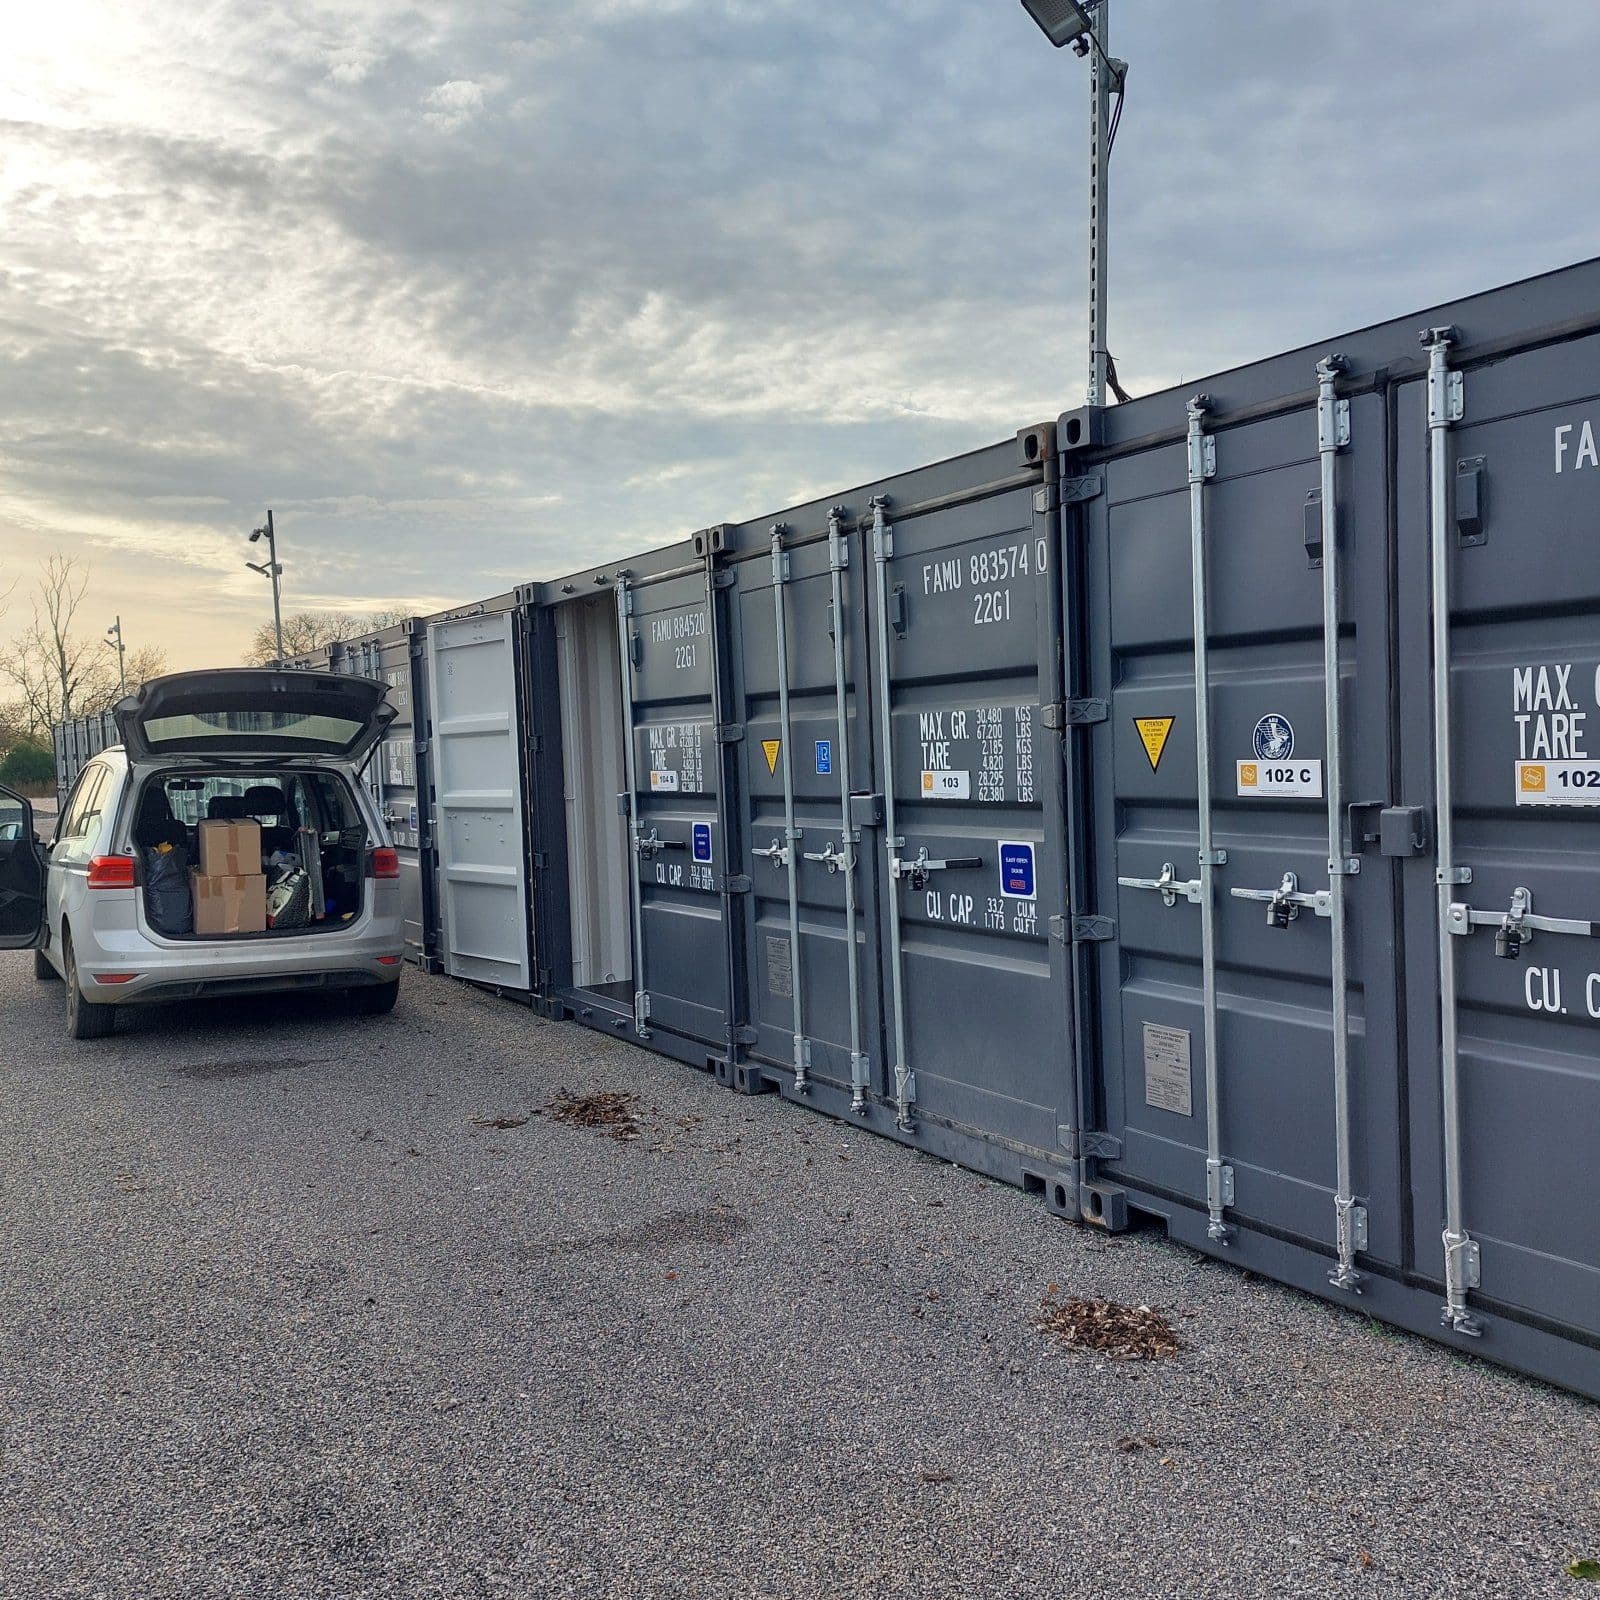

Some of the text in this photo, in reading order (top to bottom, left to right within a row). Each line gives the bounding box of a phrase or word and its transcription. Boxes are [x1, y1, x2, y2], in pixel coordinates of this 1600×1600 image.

[923, 540, 1047, 595] FAMU 883574 0
[974, 589, 1010, 625] 22G1
[652, 612, 705, 645] FAMU 884520
[675, 644, 696, 669] 22G1
[1513, 664, 1579, 712] MAX.
[976, 706, 1031, 724] 30.480 KGS
[920, 710, 970, 741] MAX. GR.
[976, 722, 1032, 740] 67.200 LBS
[1514, 712, 1588, 760] TARE
[921, 741, 951, 770] TARE
[981, 738, 1032, 755] 2.185 KGS
[982, 754, 1032, 771] 4.820 LBS
[942, 777, 959, 788] 103
[978, 770, 1033, 787] 28.295 KGS
[1265, 768, 1311, 783] 102 C
[1558, 770, 1600, 788] 102
[978, 786, 1034, 802] 62.380 LBS
[926, 890, 977, 926] CU. CAP.
[987, 897, 1004, 915] 33.2
[984, 912, 1005, 930] 1.173
[1525, 966, 1568, 1015] CU.
